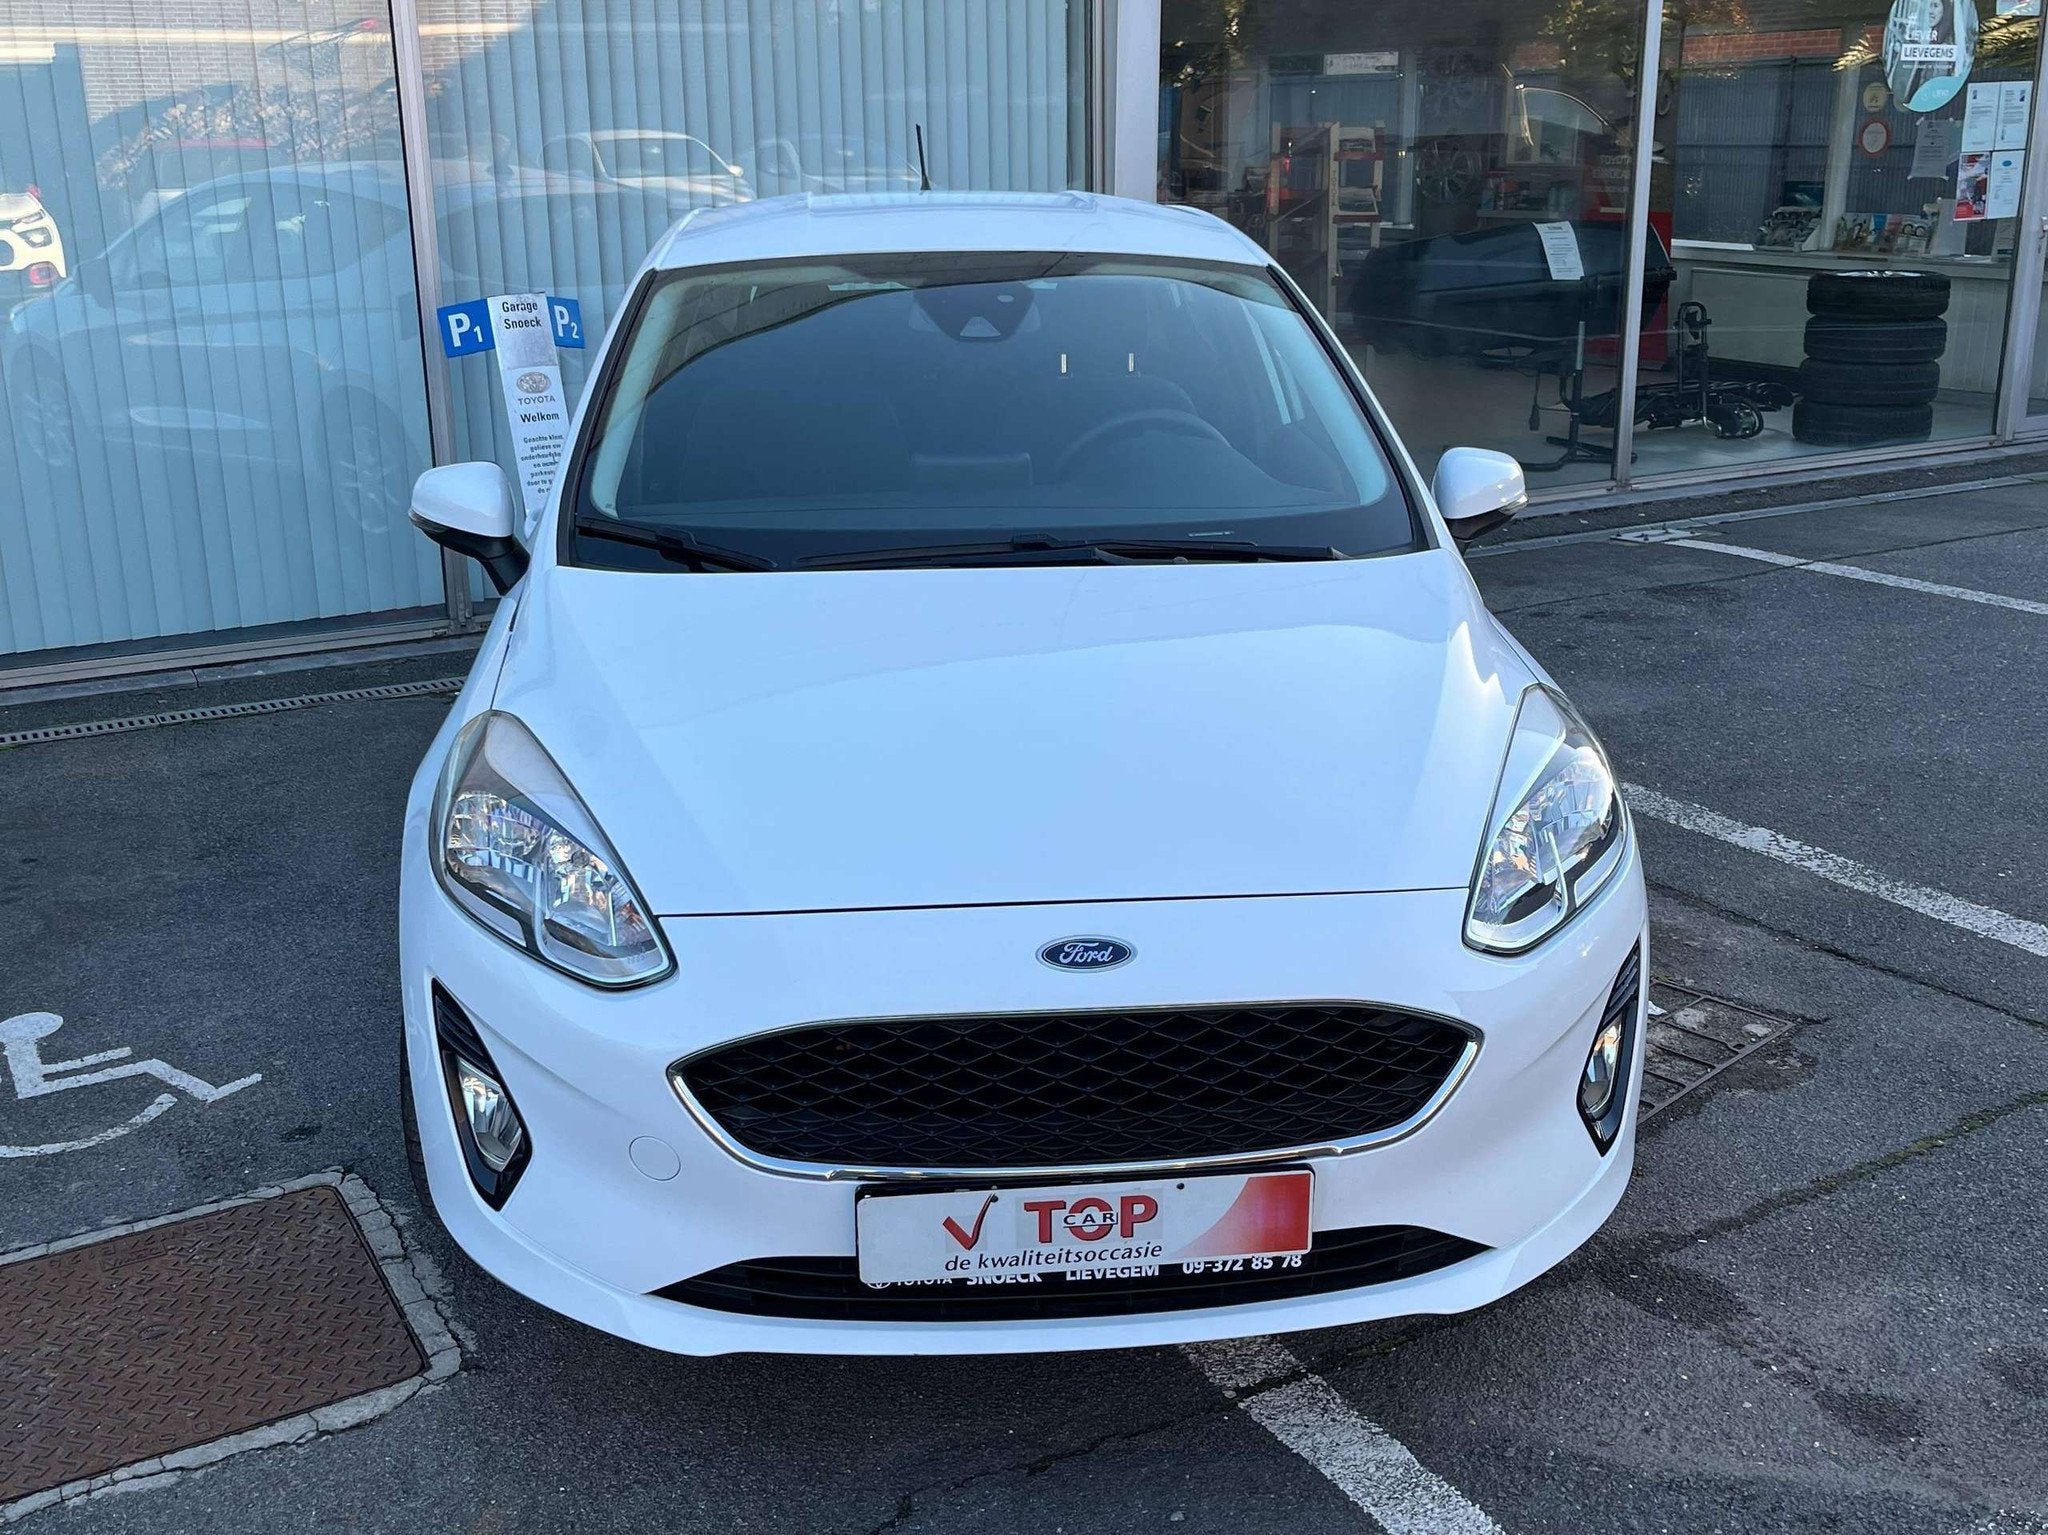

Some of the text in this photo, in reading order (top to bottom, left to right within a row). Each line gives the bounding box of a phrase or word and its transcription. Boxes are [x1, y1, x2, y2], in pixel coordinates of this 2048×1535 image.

[1903, 47, 1955, 58] LIEVEGEMS
[501, 301, 539, 315] Garage
[503, 316, 542, 330] Snoeck
[517, 395, 556, 406] TOYOTA
[519, 411, 560, 423] Welkom
[1060, 942, 1114, 964] Ford
[1024, 1194, 1159, 1244] TOP
[1063, 1211, 1118, 1227] CAR
[944, 1242, 1163, 1272] de kwaliteitsoccasie
[1066, 1264, 1160, 1281] LIEVEGEM
[1251, 1255, 1274, 1270] 85
[1281, 1253, 1303, 1268] 78
